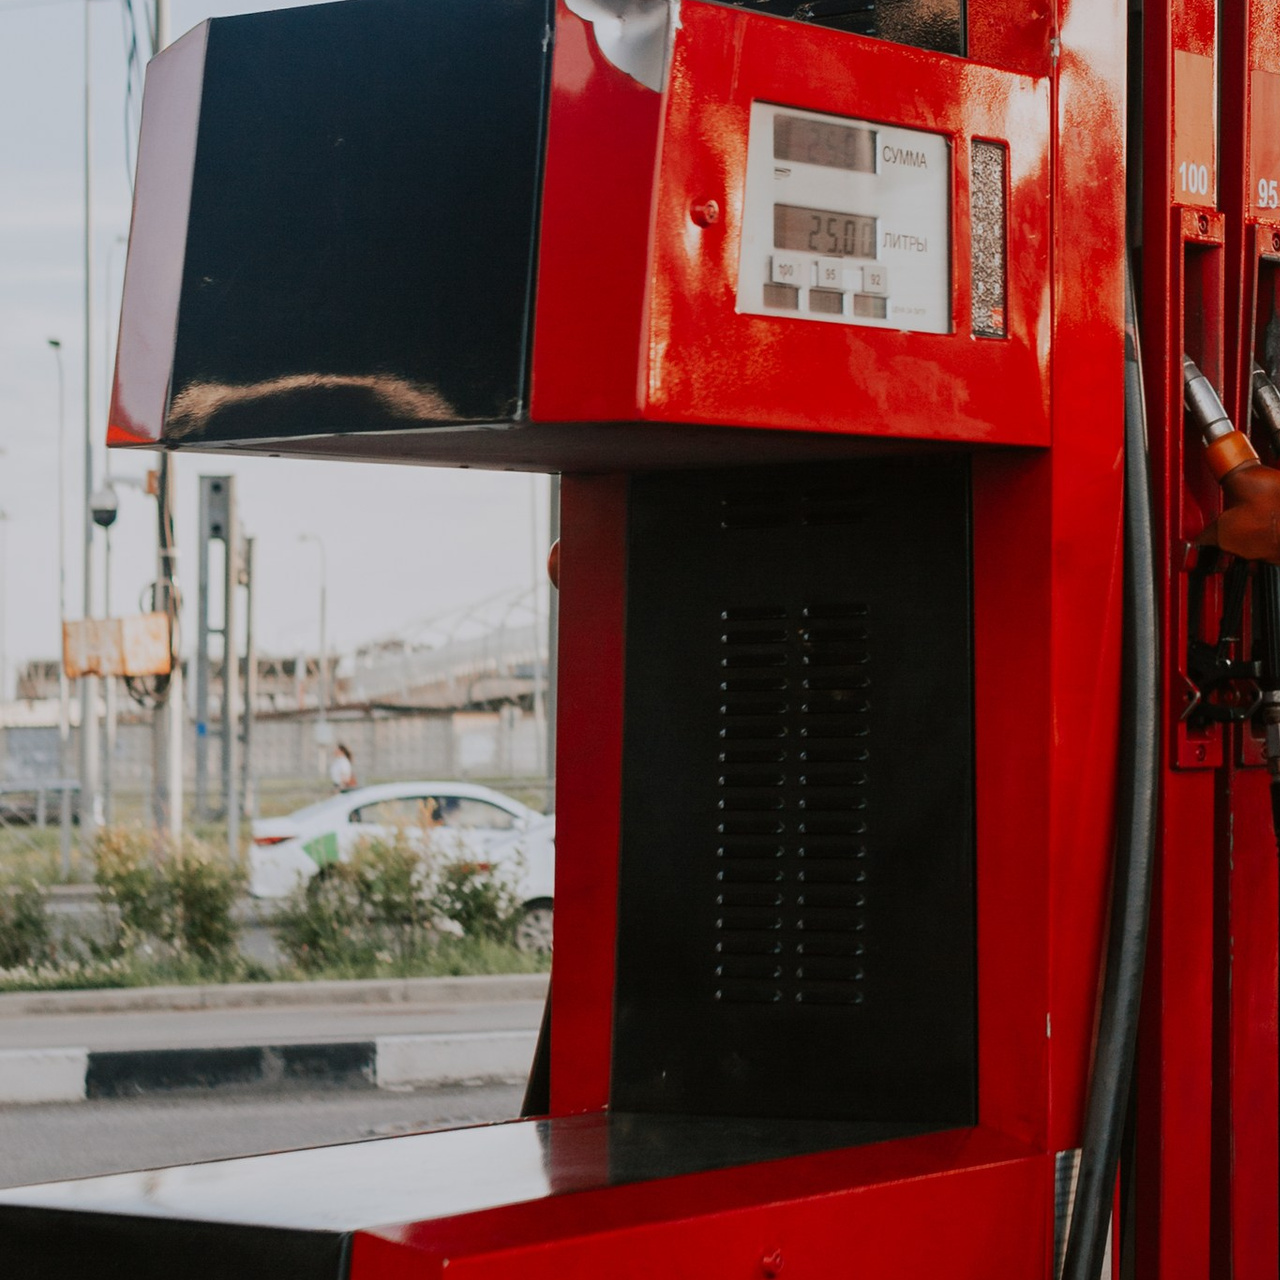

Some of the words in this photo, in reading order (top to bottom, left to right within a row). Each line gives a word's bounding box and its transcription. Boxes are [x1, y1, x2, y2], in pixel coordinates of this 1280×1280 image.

[882, 145, 928, 169] СУММА
[1178, 161, 1208, 196] 100
[1257, 178, 1278, 209] 95
[882, 232, 928, 253] ЛИТРЫ
[870, 273, 881, 286] 92
